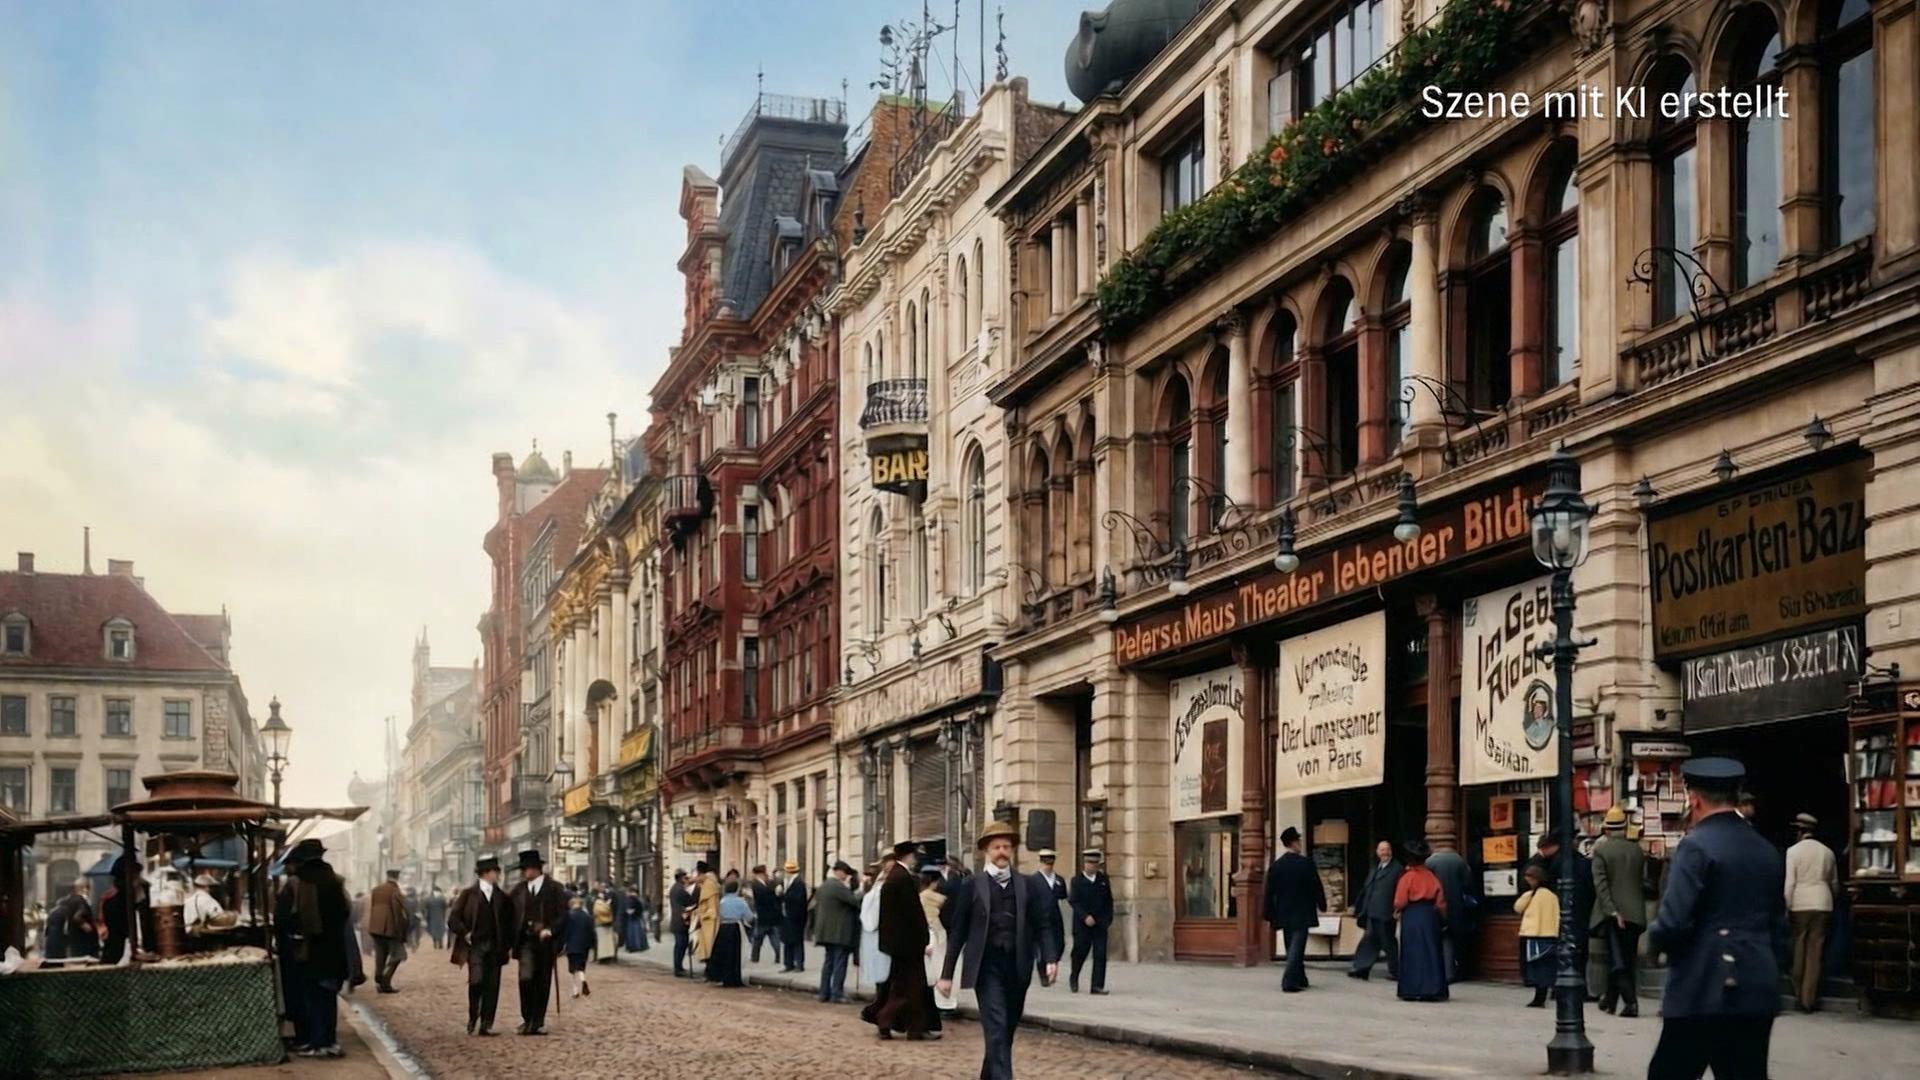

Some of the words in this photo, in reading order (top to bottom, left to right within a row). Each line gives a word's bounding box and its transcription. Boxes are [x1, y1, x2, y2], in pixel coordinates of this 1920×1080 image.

[874, 450, 927, 484] BAR
[1184, 601, 1236, 642] Maus
[1239, 570, 1324, 624] Theater
[1333, 526, 1454, 594] lebender
[1464, 486, 1531, 552] Bild
[1297, 757, 1320, 778] von
[1328, 745, 1362, 772] Paris
